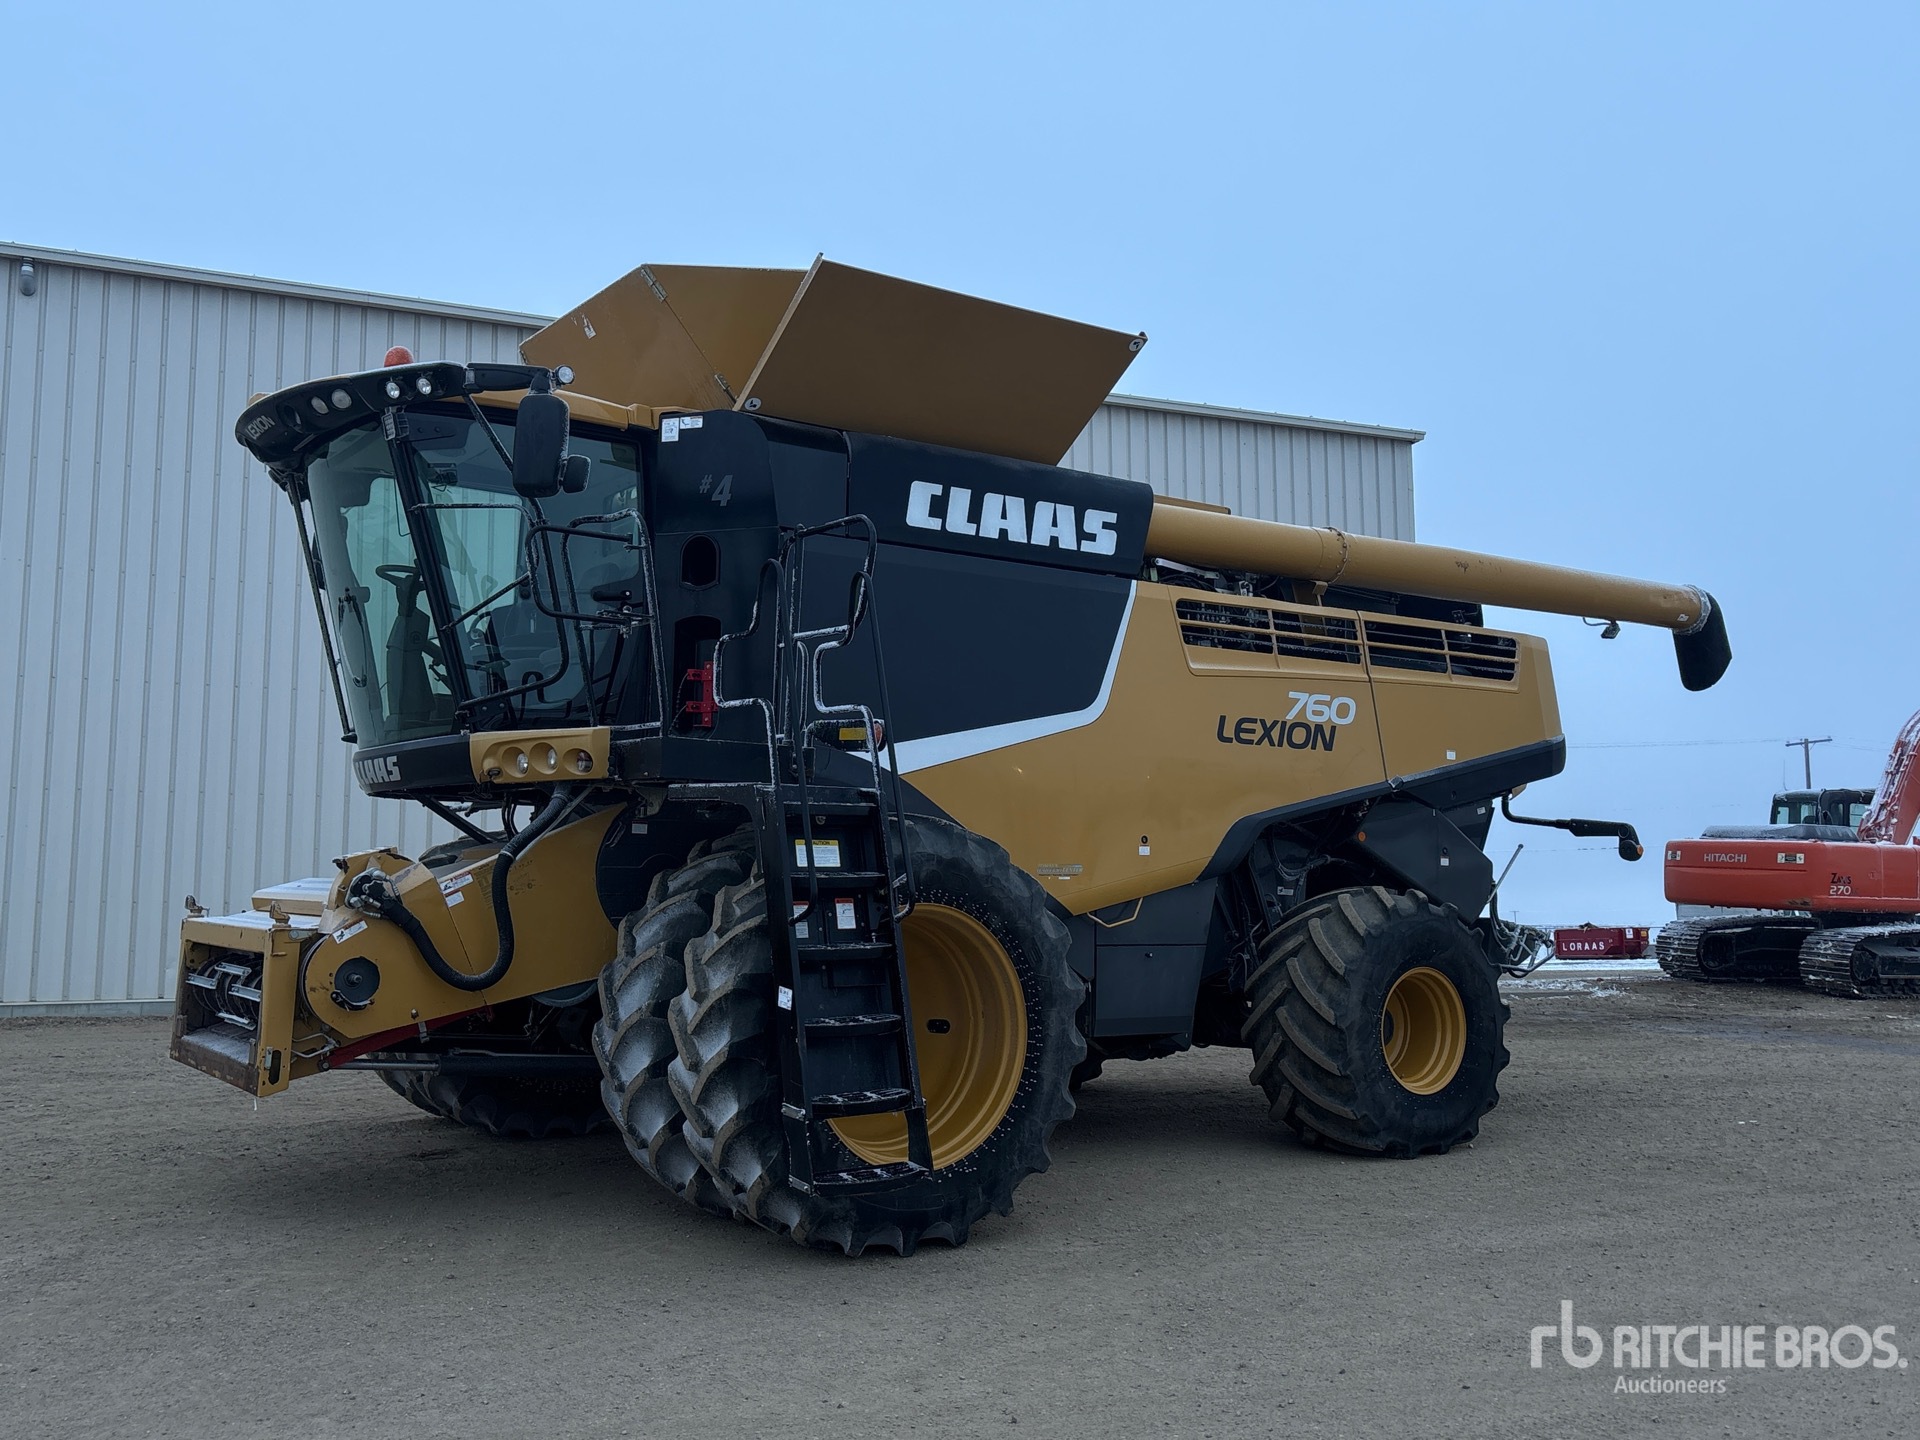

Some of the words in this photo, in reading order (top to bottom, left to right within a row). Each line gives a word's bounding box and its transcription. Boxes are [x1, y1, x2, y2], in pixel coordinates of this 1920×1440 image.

[245, 415, 276, 439] LEXION
[699, 474, 733, 507] #4
[906, 480, 1118, 556] CLAAS
[1285, 691, 1357, 725] 760
[1216, 715, 1337, 751] LEXION
[1703, 853, 1747, 863] HITACHI
[1829, 885, 1852, 896] 270
[1562, 941, 1605, 951] LORAAS
